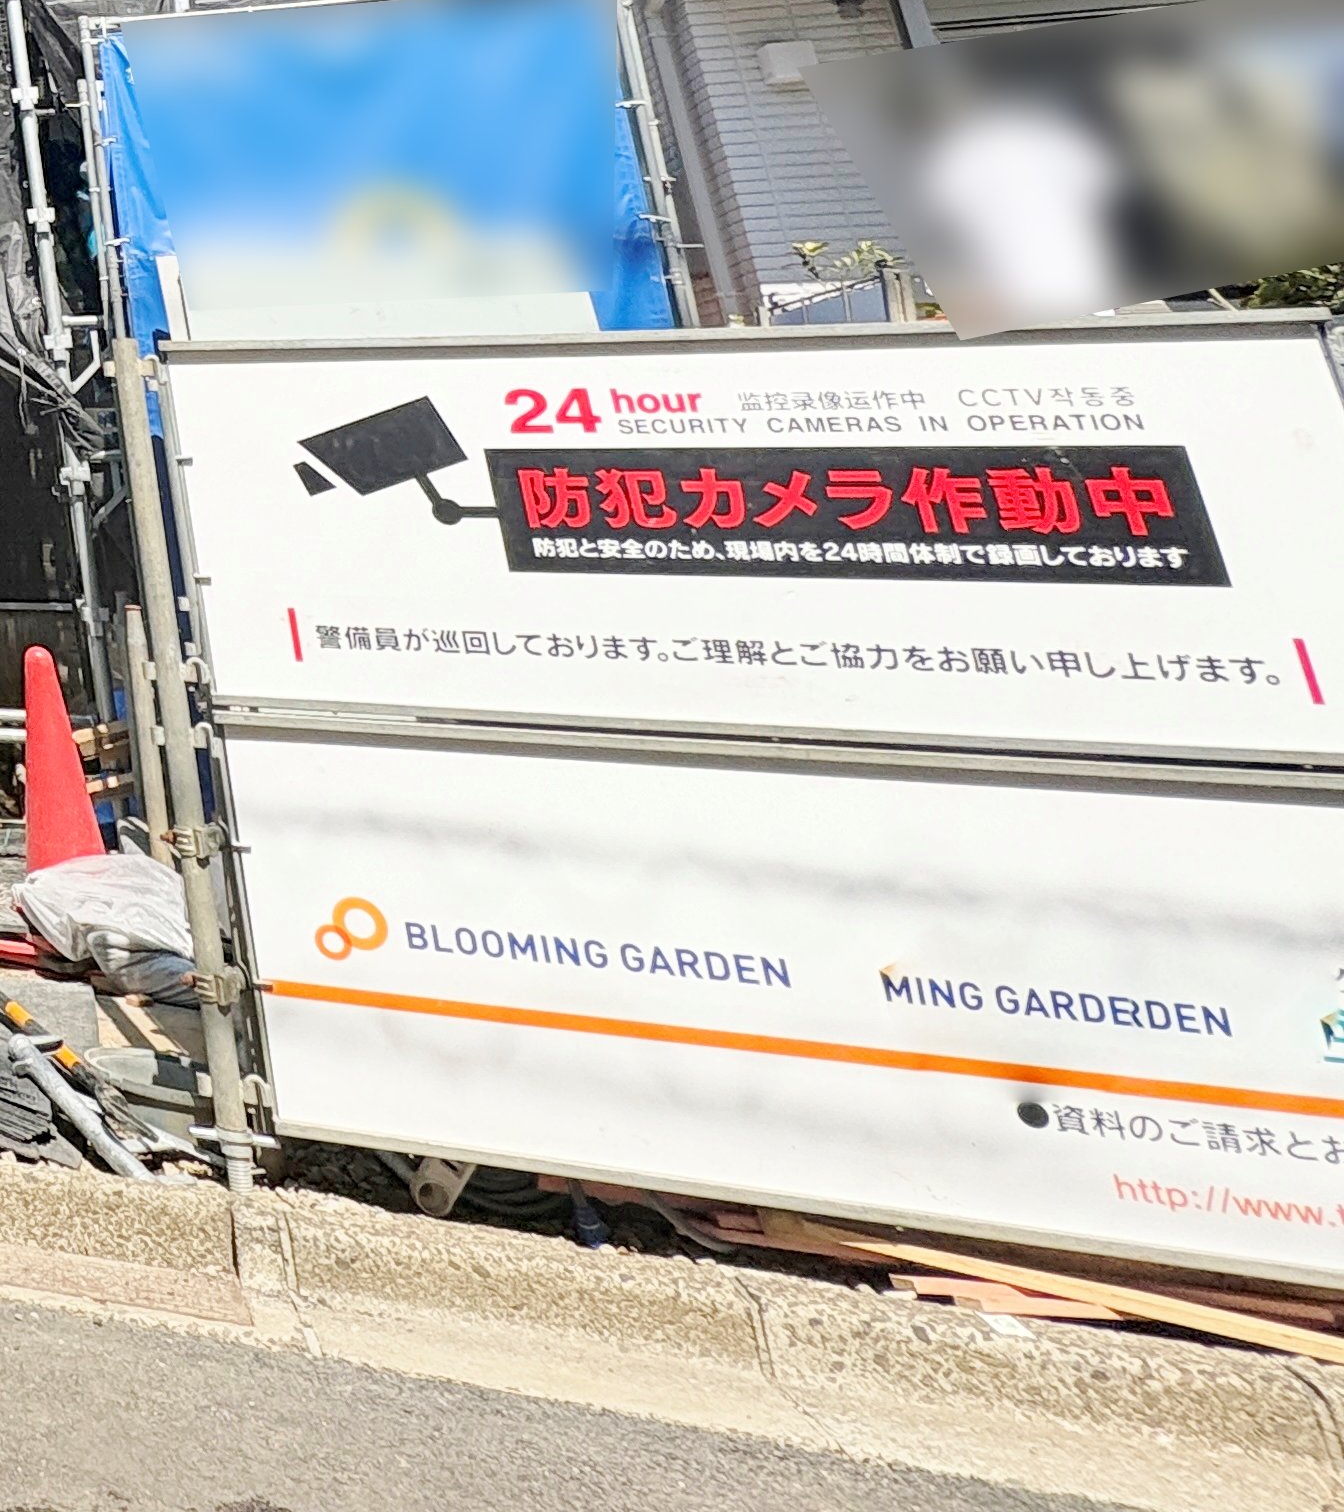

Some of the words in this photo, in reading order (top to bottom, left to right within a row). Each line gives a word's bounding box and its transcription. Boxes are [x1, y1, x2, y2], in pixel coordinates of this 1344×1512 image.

[504, 388, 603, 434] 24
[609, 388, 703, 414] hour
[738, 390, 927, 412] 监控录像运作中
[958, 386, 1136, 407] CCTV작동중
[617, 417, 748, 435] SECURITY
[766, 415, 903, 435] CAMERAS
[918, 416, 950, 433] IN
[967, 413, 1146, 433] OPERATION
[517, 466, 1175, 537] 防犯カメラ作動中
[532, 537, 1190, 569] 防犯と安全のため、現場内を24時間体制で録画しております
[404, 921, 609, 970] BLOOMING
[620, 944, 793, 989] GARDEN
[880, 972, 985, 1012] MING
